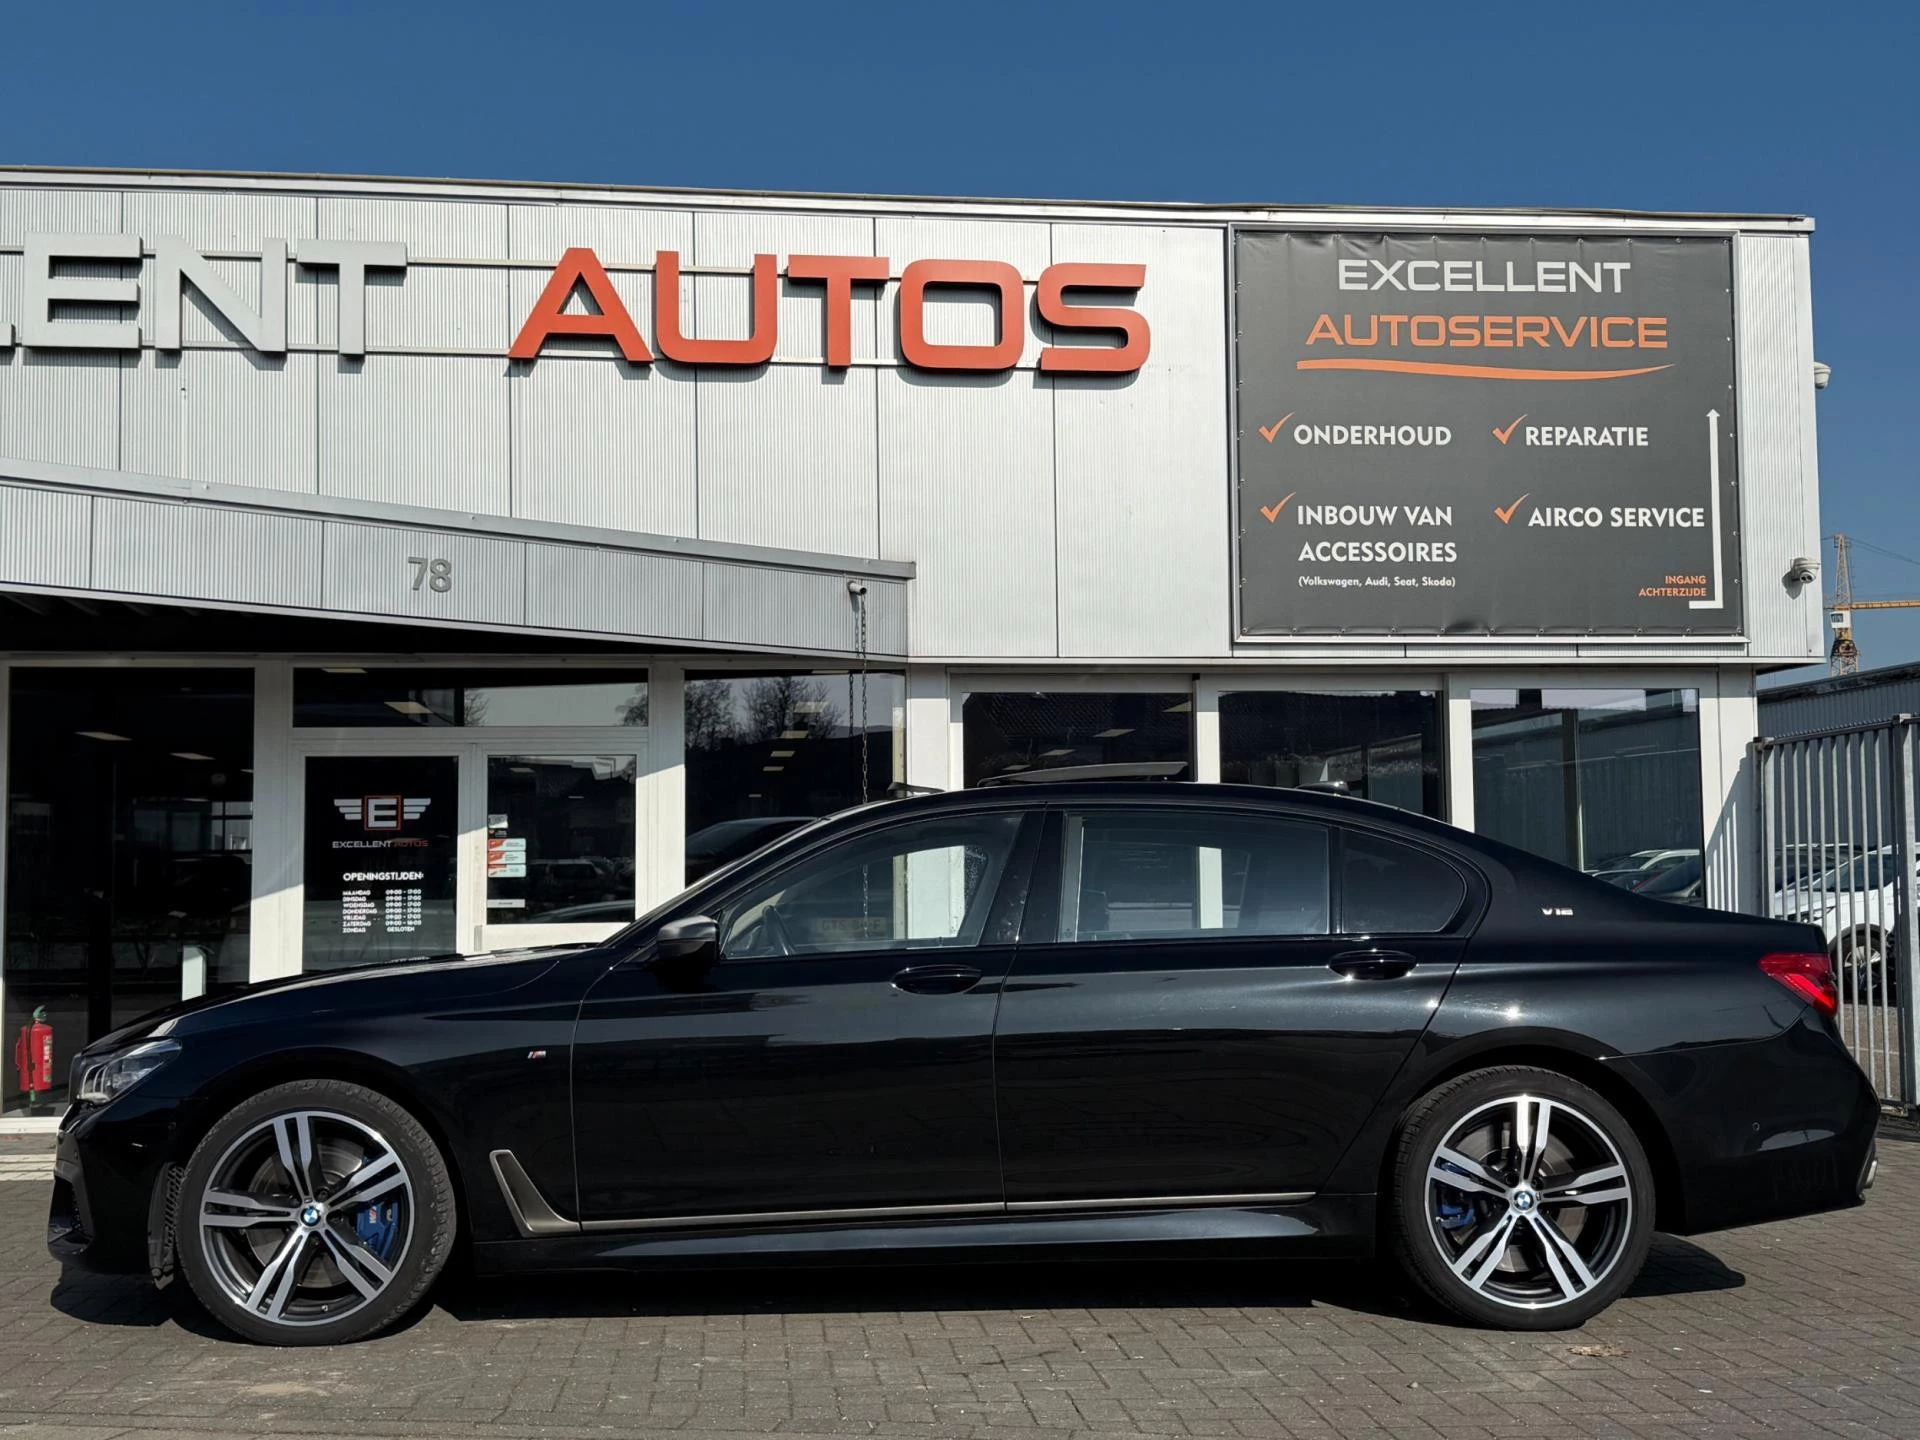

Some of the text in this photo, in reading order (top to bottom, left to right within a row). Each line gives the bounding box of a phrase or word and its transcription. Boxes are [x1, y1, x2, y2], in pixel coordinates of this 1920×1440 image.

[1338, 258, 1631, 293] EXCELLENT
[0, 231, 1150, 372] ENT AUTOS
[1306, 313, 1668, 348] AUTOSERVICE
[1293, 424, 1452, 446] ONDERHOUD
[1525, 426, 1649, 447] REPARATIE
[1297, 504, 1453, 526] INBOUW VAN
[1527, 506, 1705, 528] AIRCO SERVICE
[1298, 541, 1458, 563] ACCESSOIRES
[408, 556, 452, 593] 78
[1298, 576, 1456, 588] (Volkswagen, Audi, Seat, Skoda)
[1664, 575, 1707, 585] INGANG
[1639, 587, 1707, 597] ACHTERZIJDE
[332, 840, 392, 848] EXCELLENT
